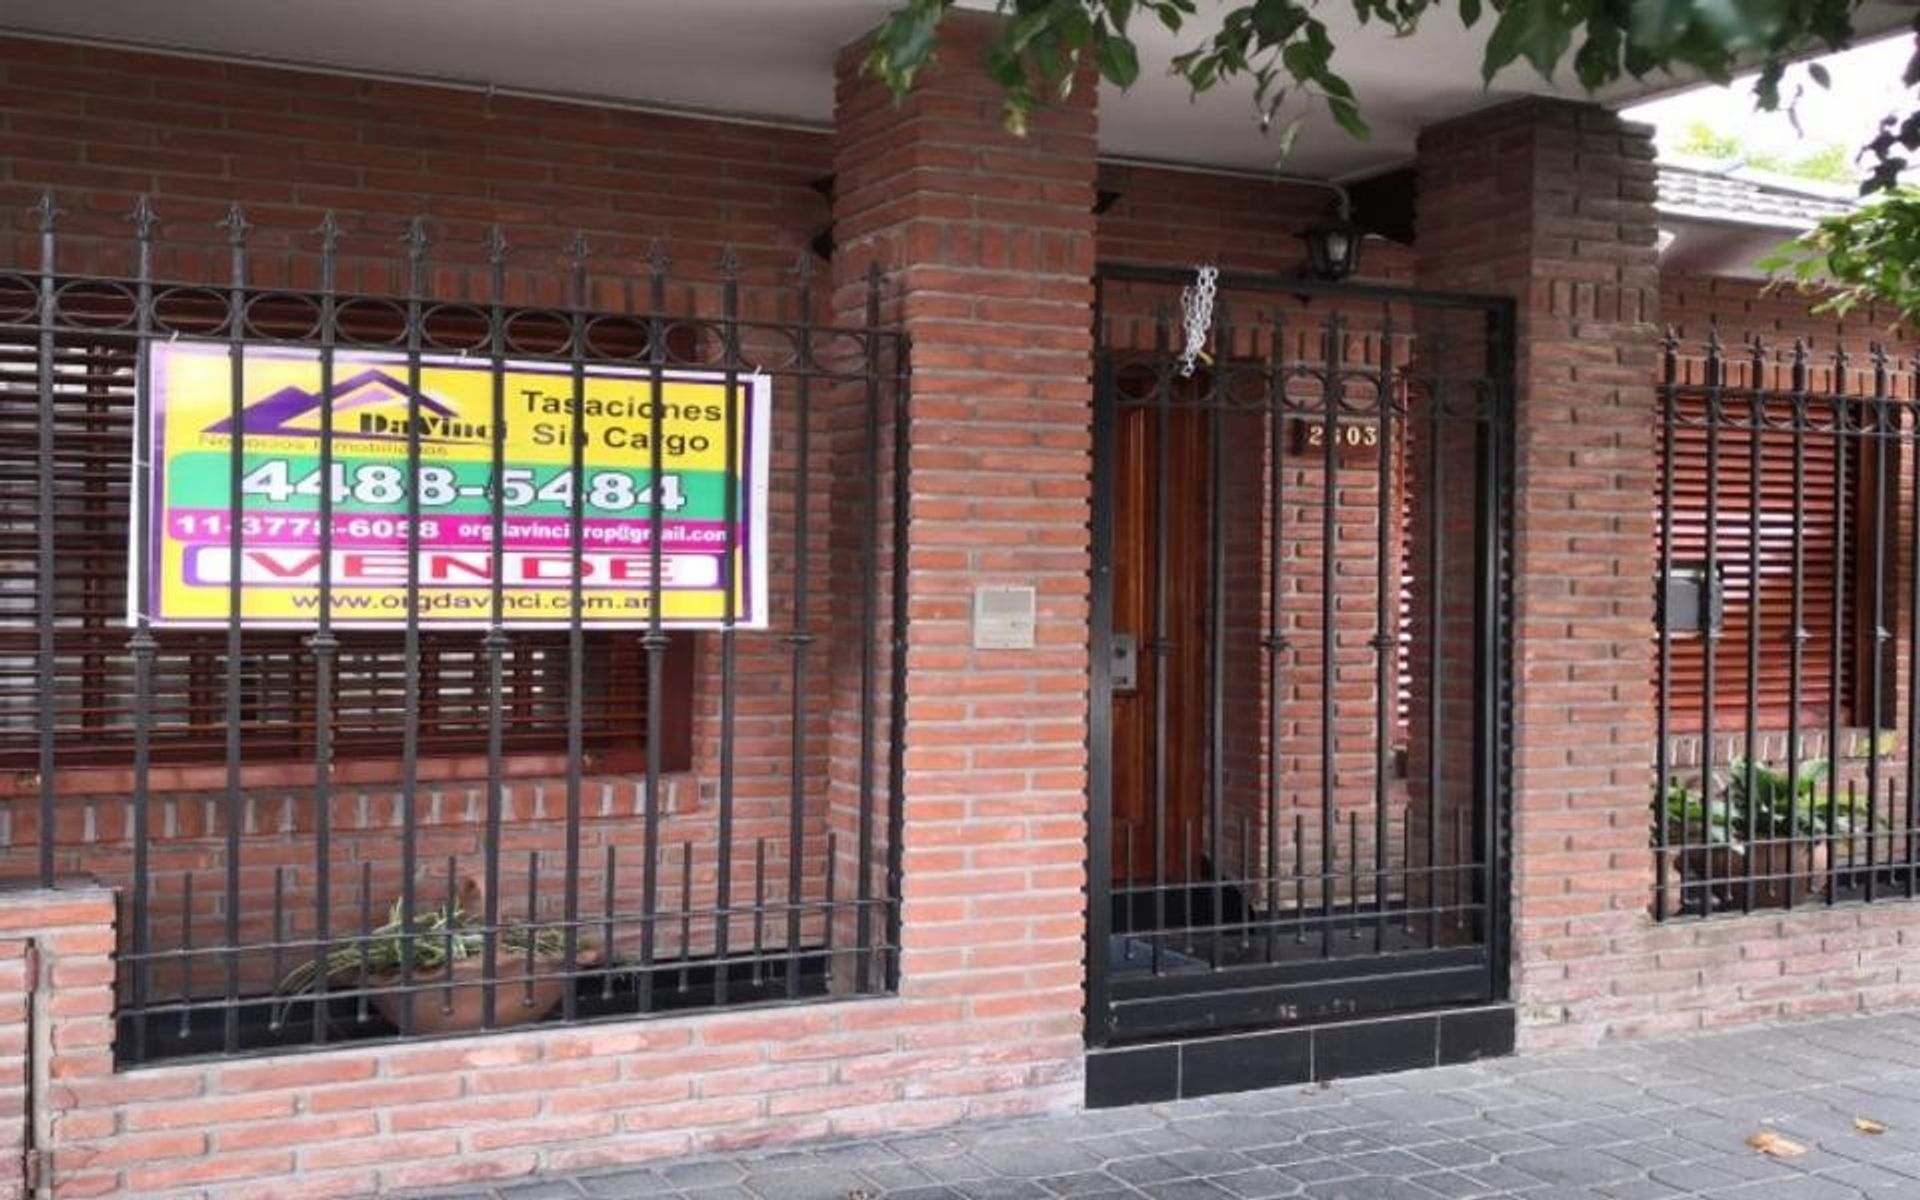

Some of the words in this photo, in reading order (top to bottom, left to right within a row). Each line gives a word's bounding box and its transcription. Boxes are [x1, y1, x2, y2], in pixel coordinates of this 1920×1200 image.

[521, 389, 722, 421] Tasaciones
[360, 413, 506, 438] DaVinc
[199, 434, 304, 451] Neocios
[603, 426, 710, 455] Cago
[240, 458, 687, 511] 4488-5484
[459, 521, 727, 543] orgavincirop@gail.com
[246, 552, 673, 580] VENDE
[292, 593, 656, 613] www.orgdavnci.cm.ar
